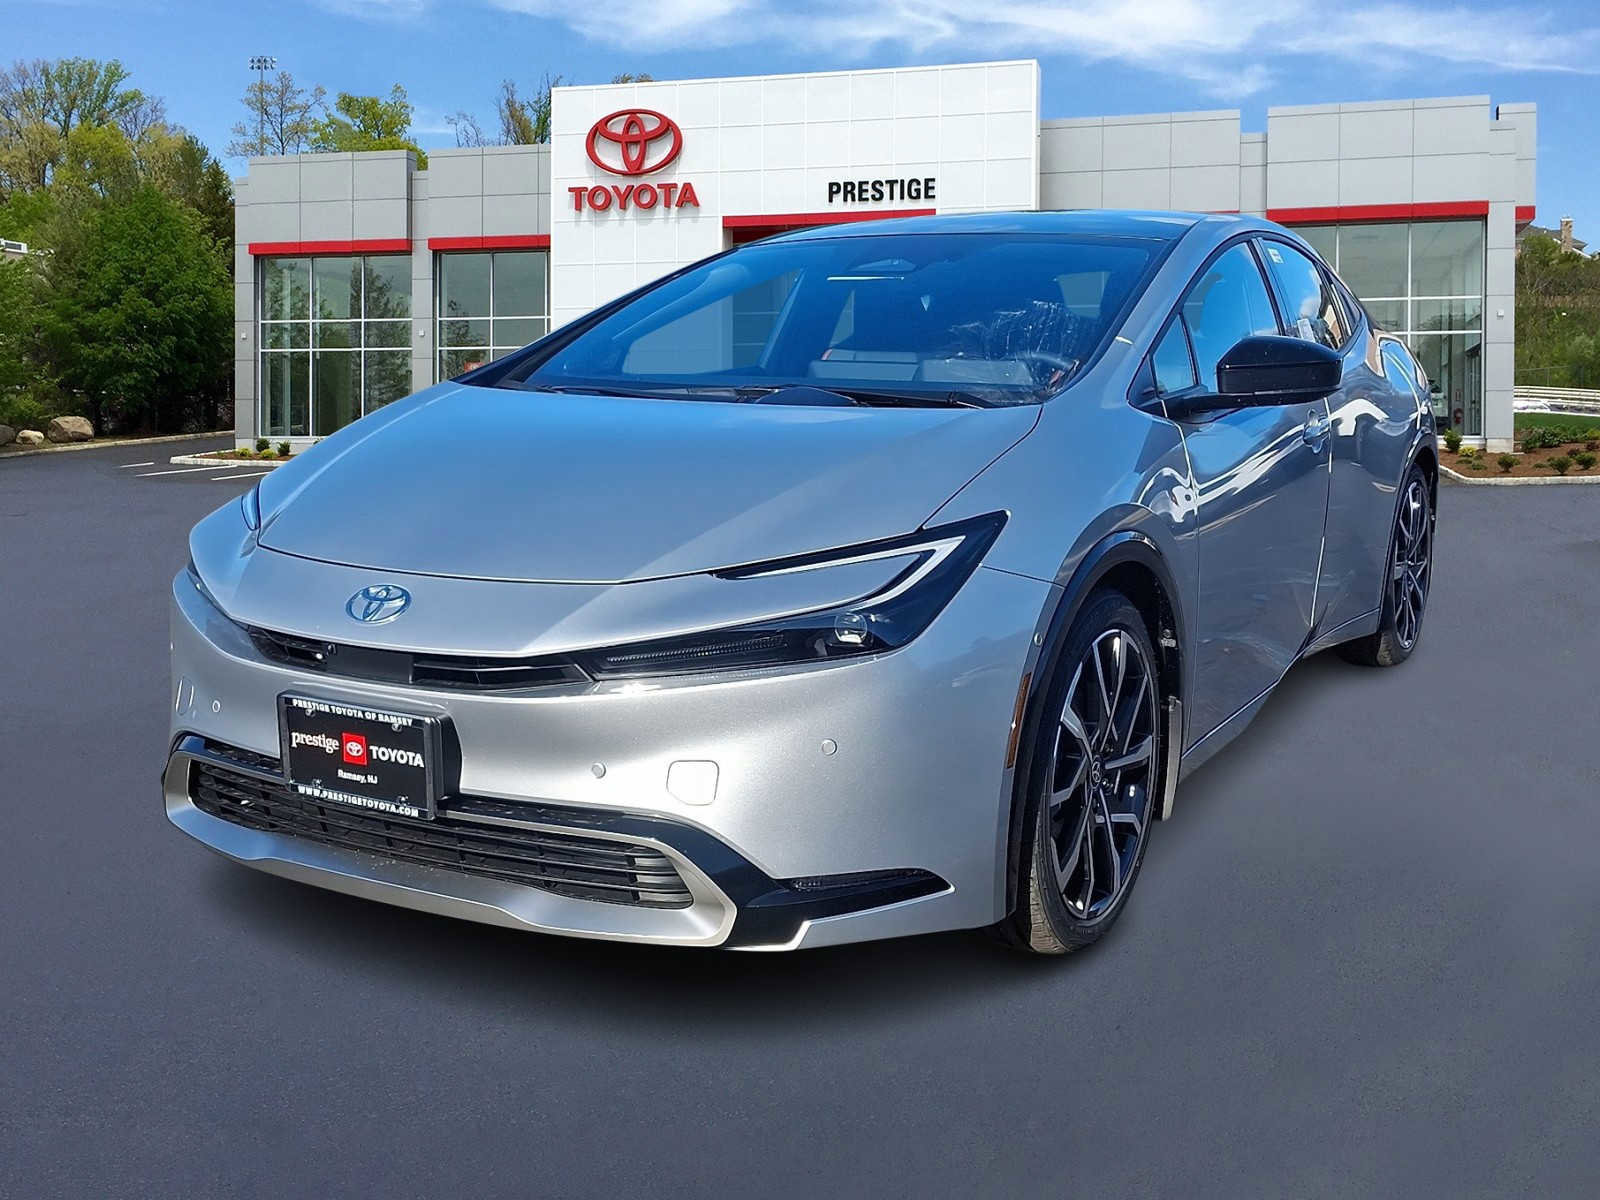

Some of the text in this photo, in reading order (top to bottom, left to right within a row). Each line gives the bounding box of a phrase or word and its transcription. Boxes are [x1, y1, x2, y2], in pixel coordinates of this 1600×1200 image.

[568, 182, 701, 212] TOYOTA
[828, 178, 937, 203] PRESTIGE
[292, 699, 413, 727] PRESTIGE TOYOTA OF RAMSEY
[291, 731, 340, 754] prestige
[369, 745, 425, 768] TOYOTA
[297, 785, 419, 817] WWW.PRESTIGETOYOTA.COM
